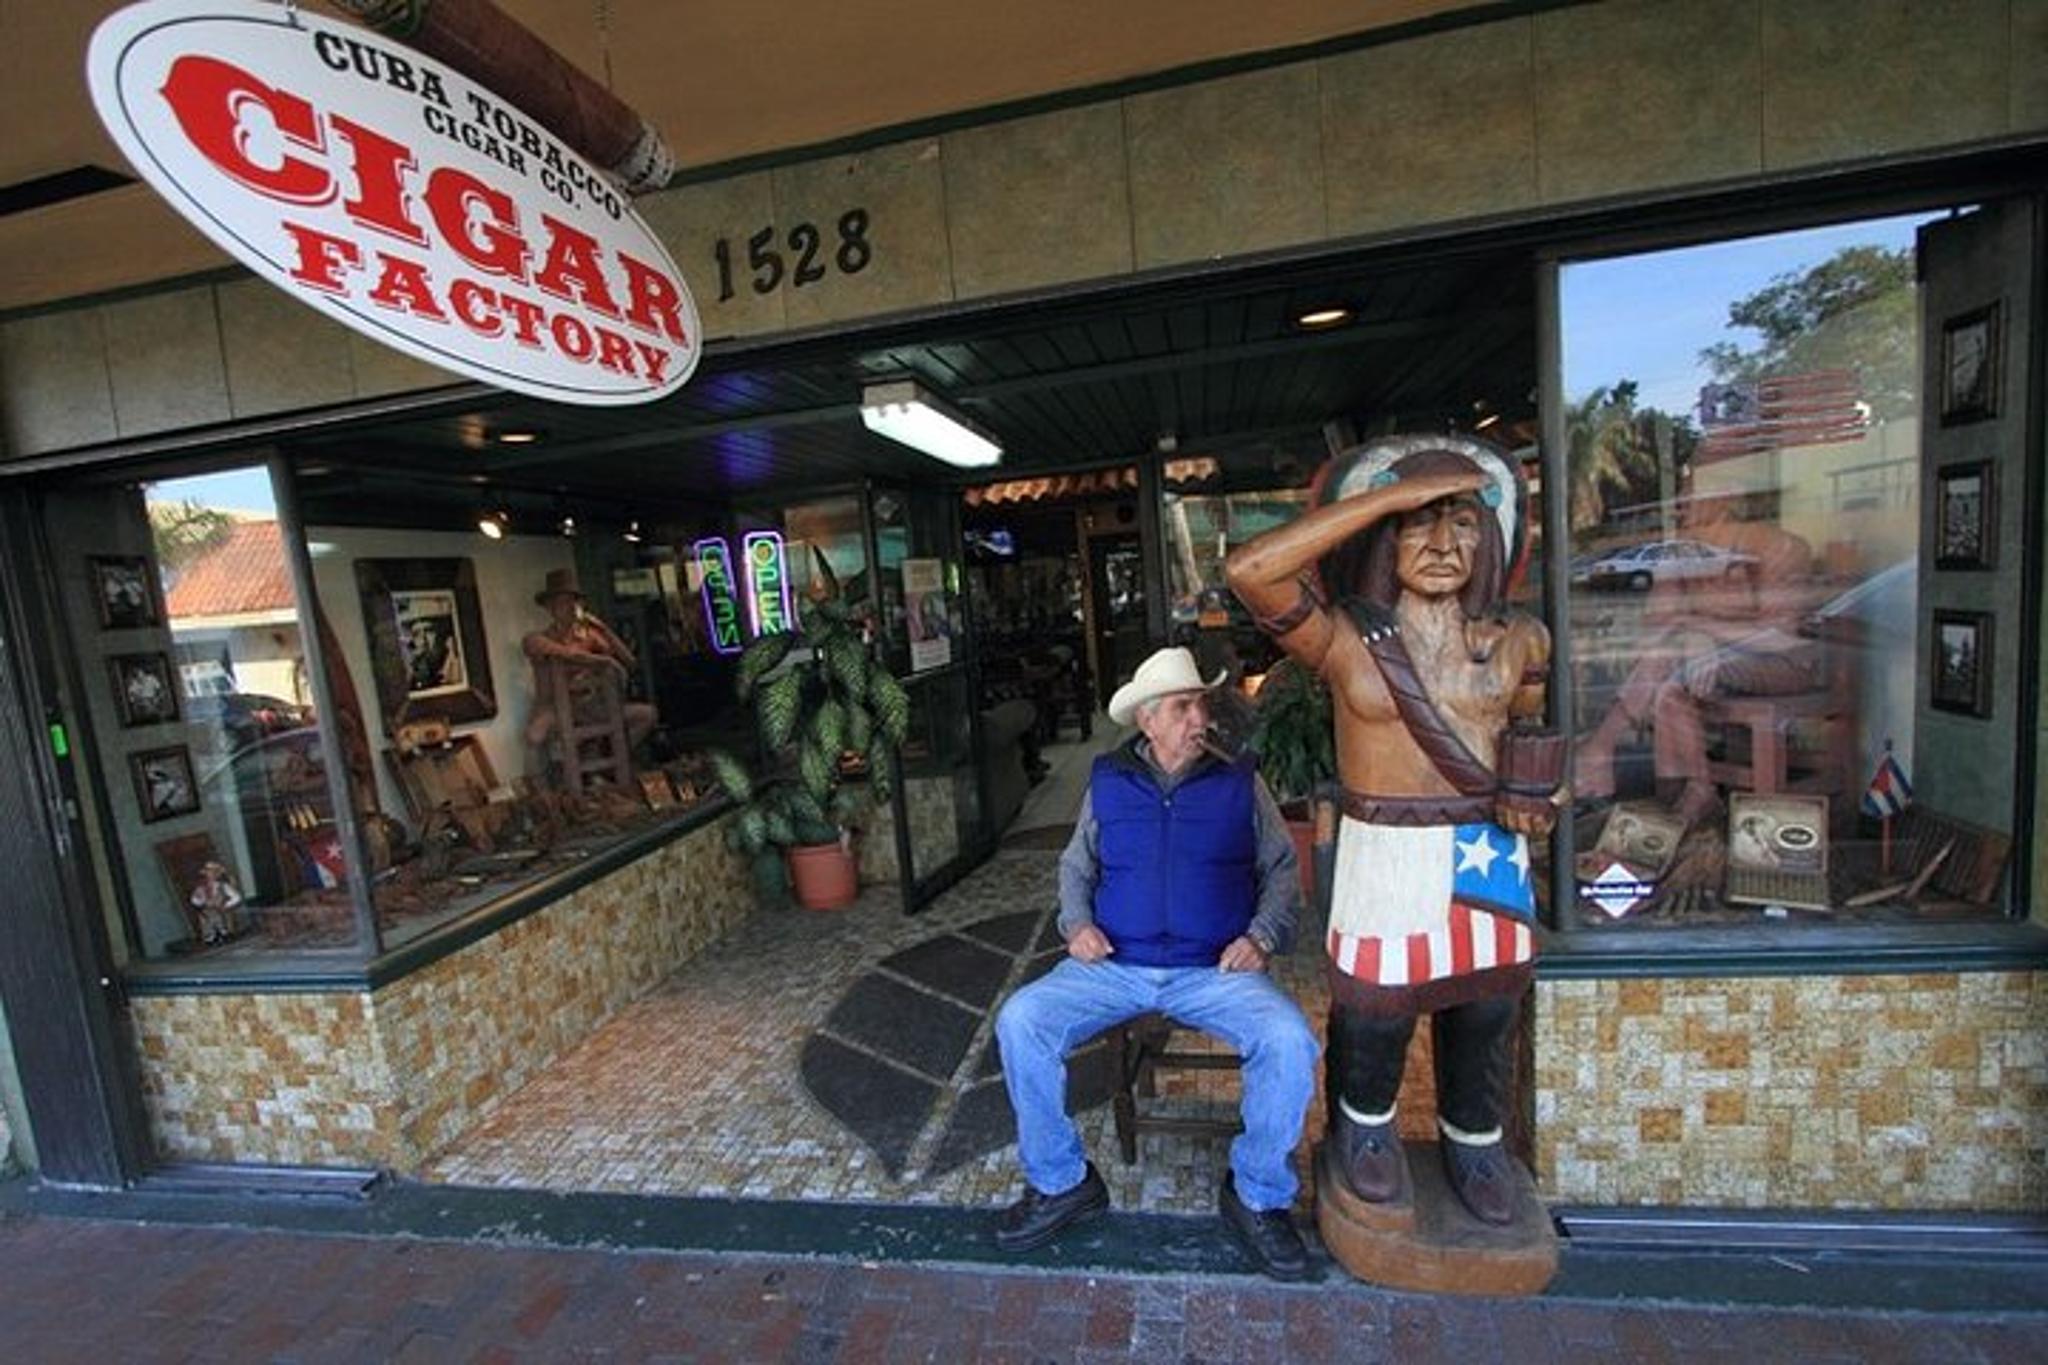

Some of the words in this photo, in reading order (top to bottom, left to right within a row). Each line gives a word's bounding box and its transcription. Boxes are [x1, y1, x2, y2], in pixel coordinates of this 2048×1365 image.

[160, 55, 689, 348] CIGAR
[314, 30, 453, 108] CUBA
[466, 91, 622, 220] TOBACCO
[423, 105, 527, 177] CIGAR
[541, 167, 581, 210] CO.
[282, 221, 672, 387] FACTORY
[713, 207, 872, 303] 1528
